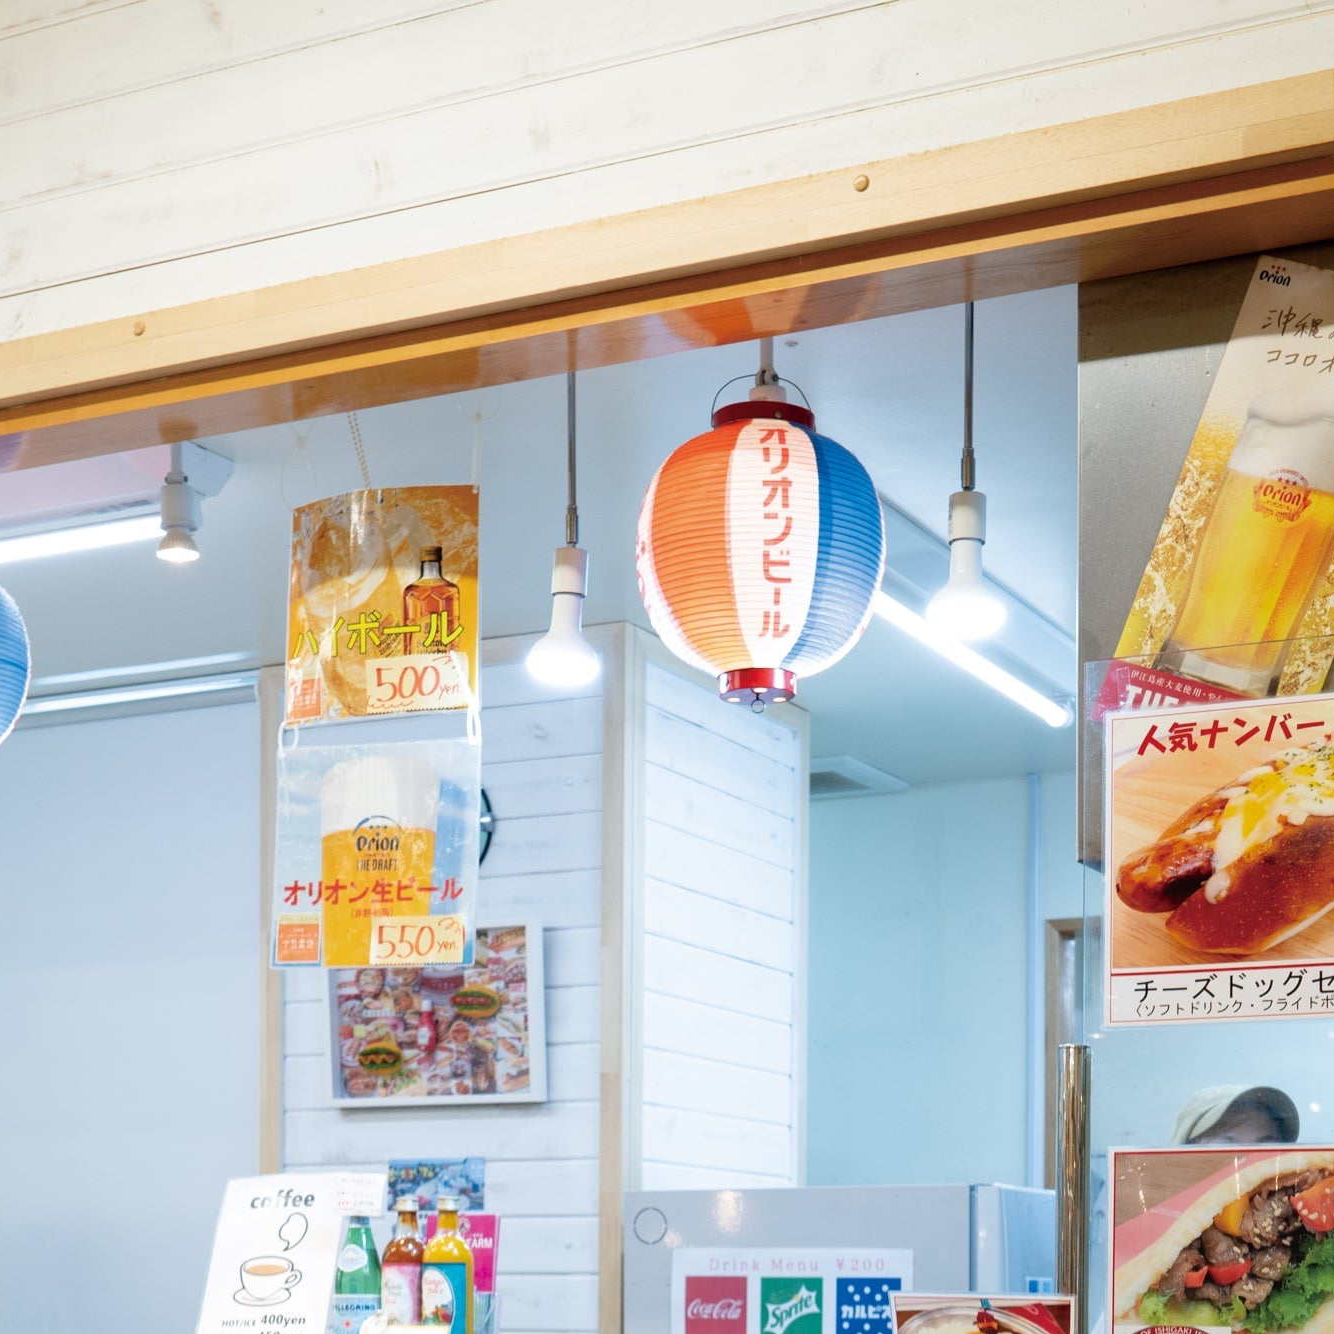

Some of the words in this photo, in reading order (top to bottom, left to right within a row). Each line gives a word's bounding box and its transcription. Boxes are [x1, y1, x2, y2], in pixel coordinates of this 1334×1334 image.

[1259, 268, 1291, 287] Orion
[1263, 485, 1301, 506] Orion
[758, 428, 793, 640] オリオンビール
[292, 610, 465, 658] ハイボール
[376, 665, 440, 702] 500
[356, 831, 399, 851] Orion
[372, 859, 398, 872] DRAFT
[284, 876, 464, 905] オリオン生ビール
[376, 925, 436, 959] 550
[709, 1258, 760, 1272] Drink
[771, 1258, 819, 1272] Menu
[835, 1258, 885, 1272] ¥200
[770, 1294, 814, 1328] Sprite
[841, 1304, 891, 1319] カルピス
